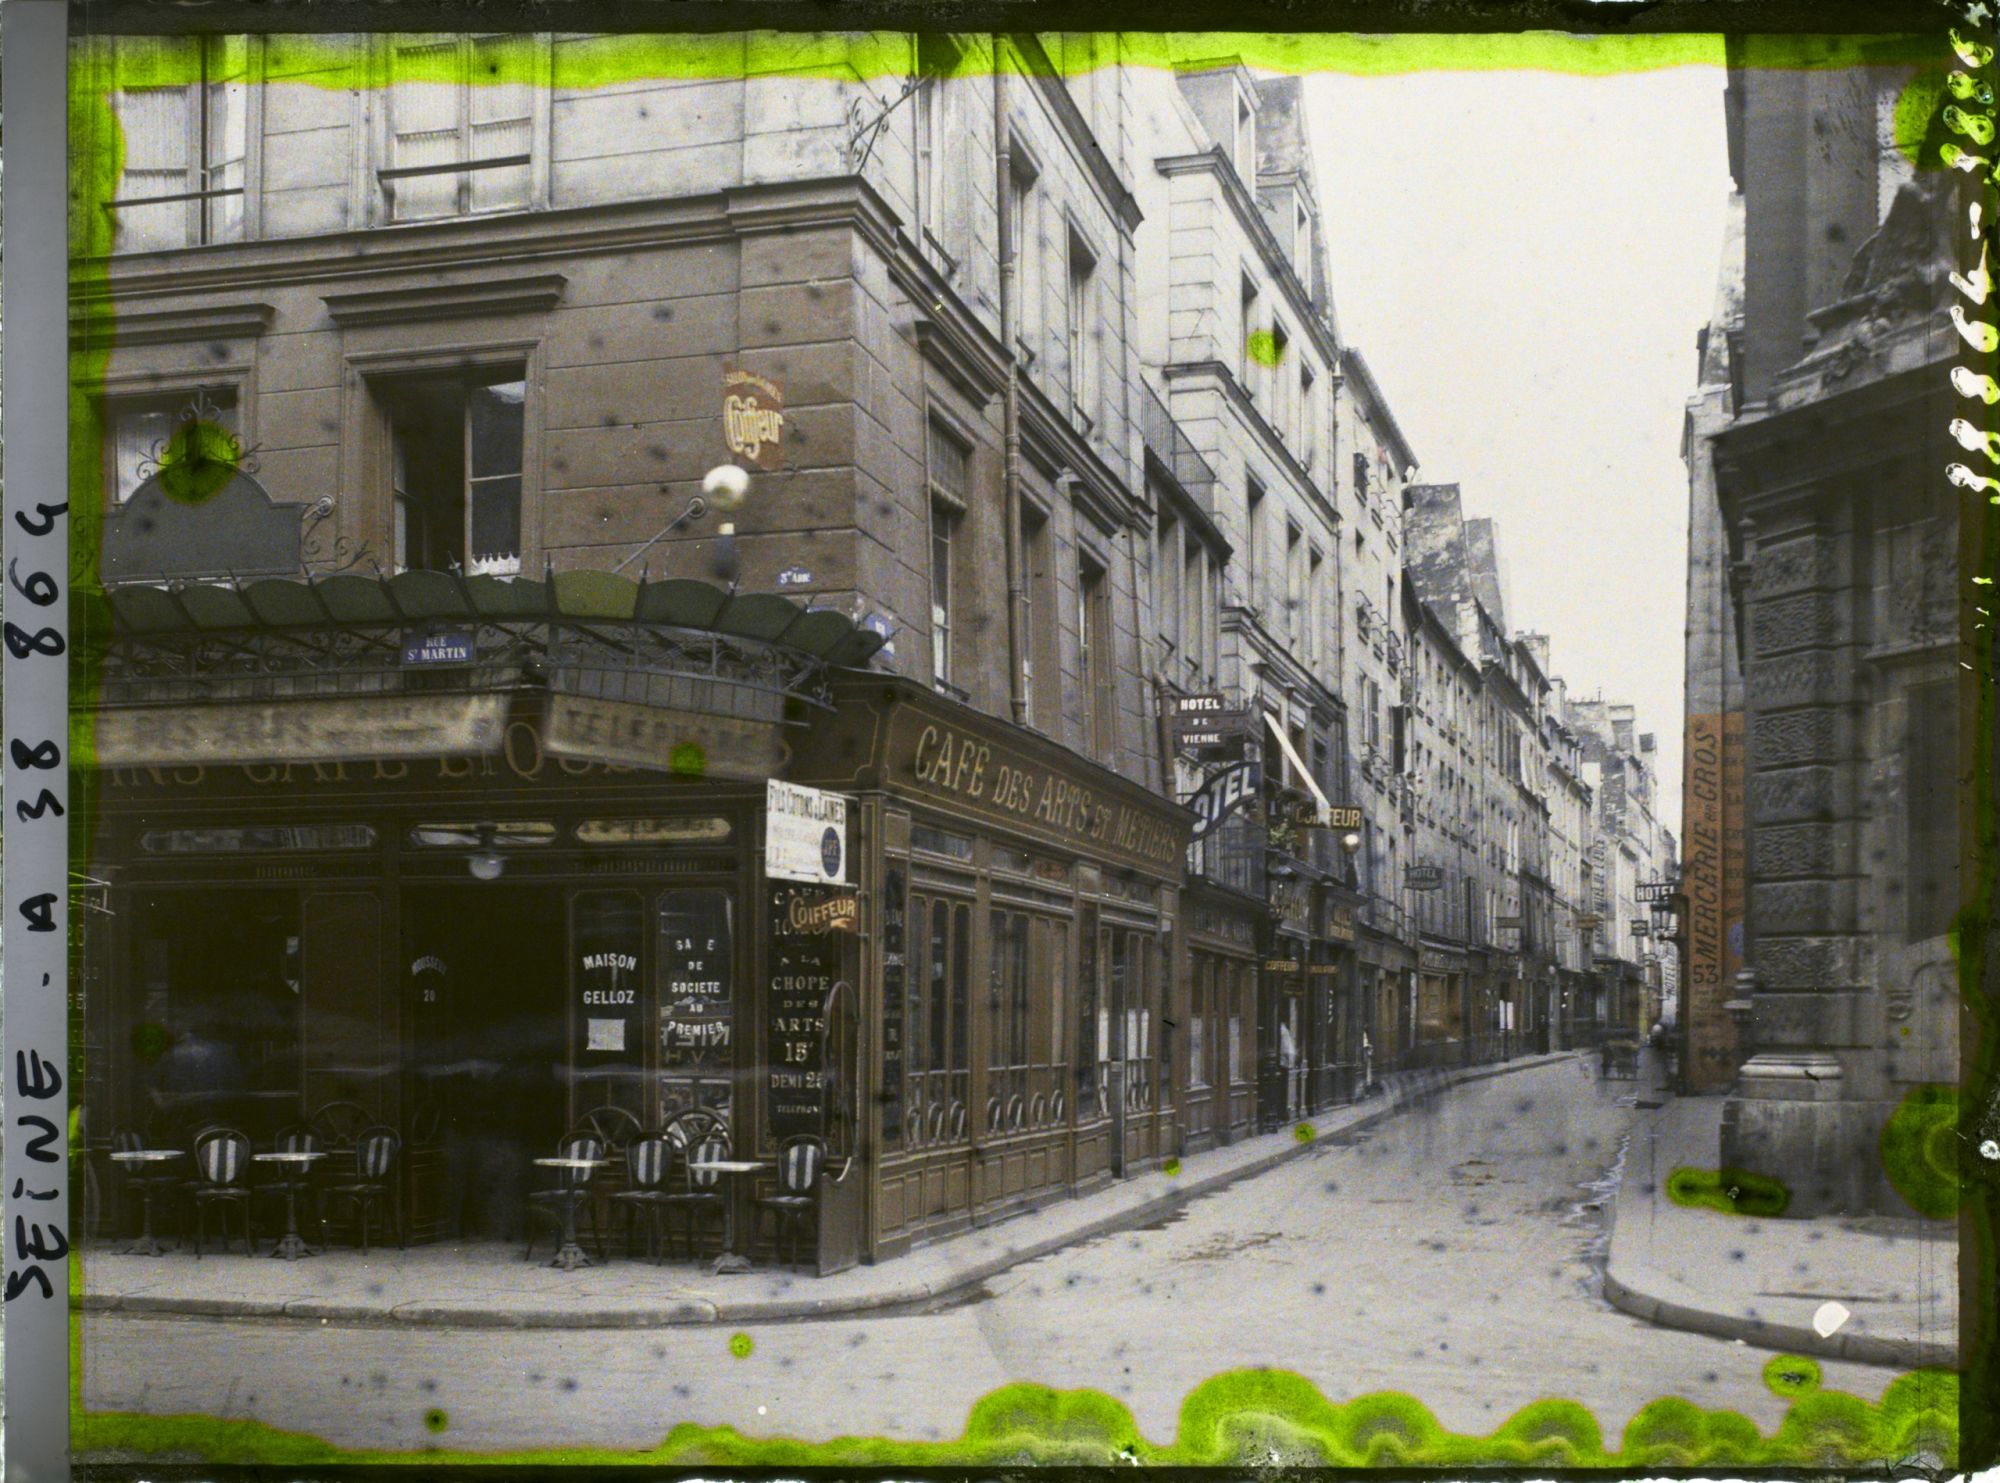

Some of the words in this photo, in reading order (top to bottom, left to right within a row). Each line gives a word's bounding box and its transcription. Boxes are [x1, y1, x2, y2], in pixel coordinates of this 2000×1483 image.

[426, 636, 447, 647] RUE
[421, 647, 467, 660] MARTIN
[1180, 698, 1221, 710] HOTEL
[1193, 718, 1208, 726] DE
[1182, 733, 1221, 743] VIENNE
[1693, 720, 1717, 801] GROS
[11, 738, 64, 822] 38
[914, 725, 991, 797] CAFÉ
[993, 765, 1033, 813] DES
[1034, 774, 1092, 832] ARTS
[767, 784, 785, 813] FILS
[1192, 766, 1256, 833] OTEL
[1694, 822, 1718, 962] MERCERIE
[19, 892, 57, 932] A
[789, 896, 856, 929] COIFFEUR
[583, 952, 637, 971] MAISON
[687, 961, 703, 971] DE
[1692, 964, 1719, 984] 53
[671, 982, 720, 993] SOCIETE
[771, 975, 830, 991] CHOPE
[583, 990, 635, 1005] GELLOZ
[783, 1000, 819, 1008] DES
[689, 1003, 704, 1013] AU
[667, 1021, 725, 1036] PREMIER
[774, 1018, 825, 1032] ARTS
[771, 1073, 802, 1089] DEMI
